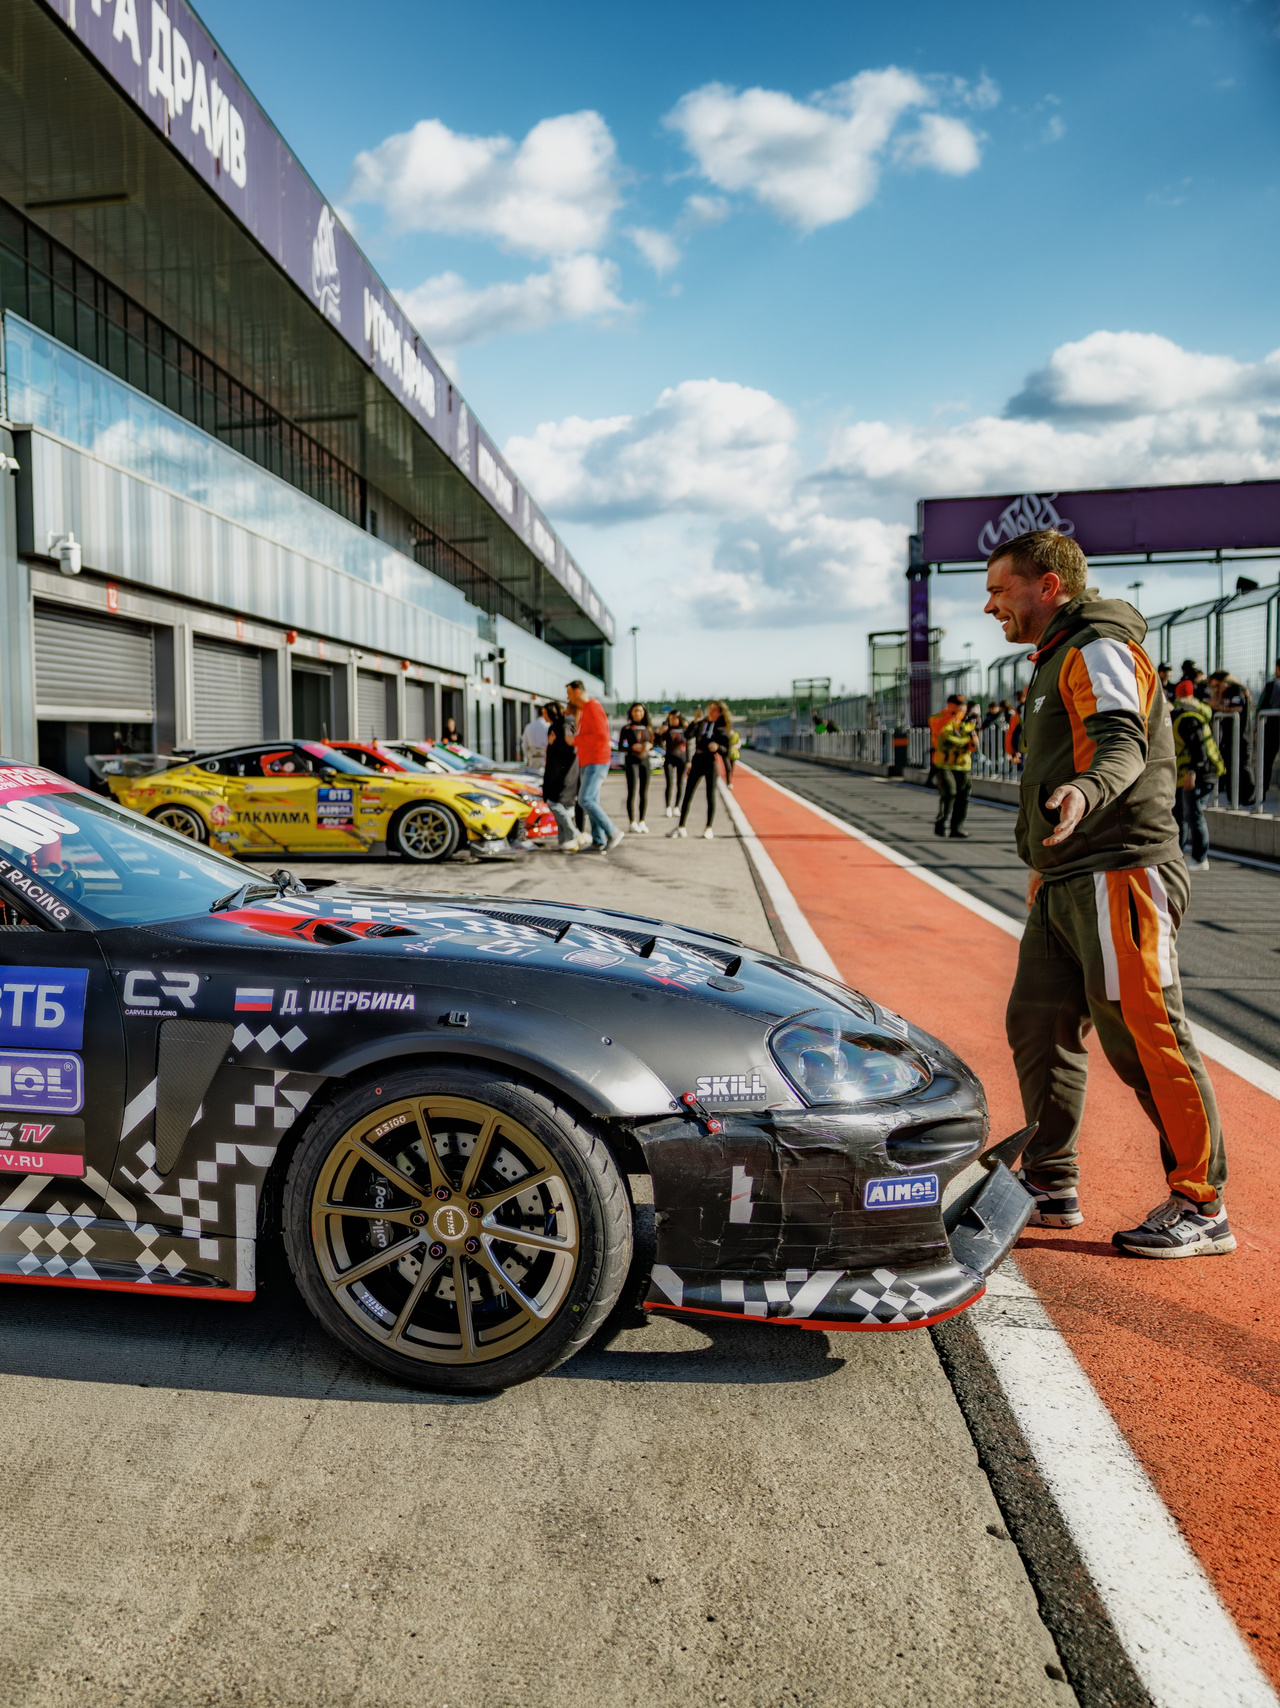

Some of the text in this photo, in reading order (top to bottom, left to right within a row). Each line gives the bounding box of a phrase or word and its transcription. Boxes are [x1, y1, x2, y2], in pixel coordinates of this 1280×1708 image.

[235, 811, 310, 824] TAKAYAMA
[5, 868, 70, 921] RACING
[123, 970, 200, 1008] CR
[280, 990, 415, 1015] Д. ЩЕРБИНА
[696, 1075, 766, 1096] SKILL
[733, 1093, 766, 1101] WHEELS
[868, 1181, 935, 1202] AIMOL
